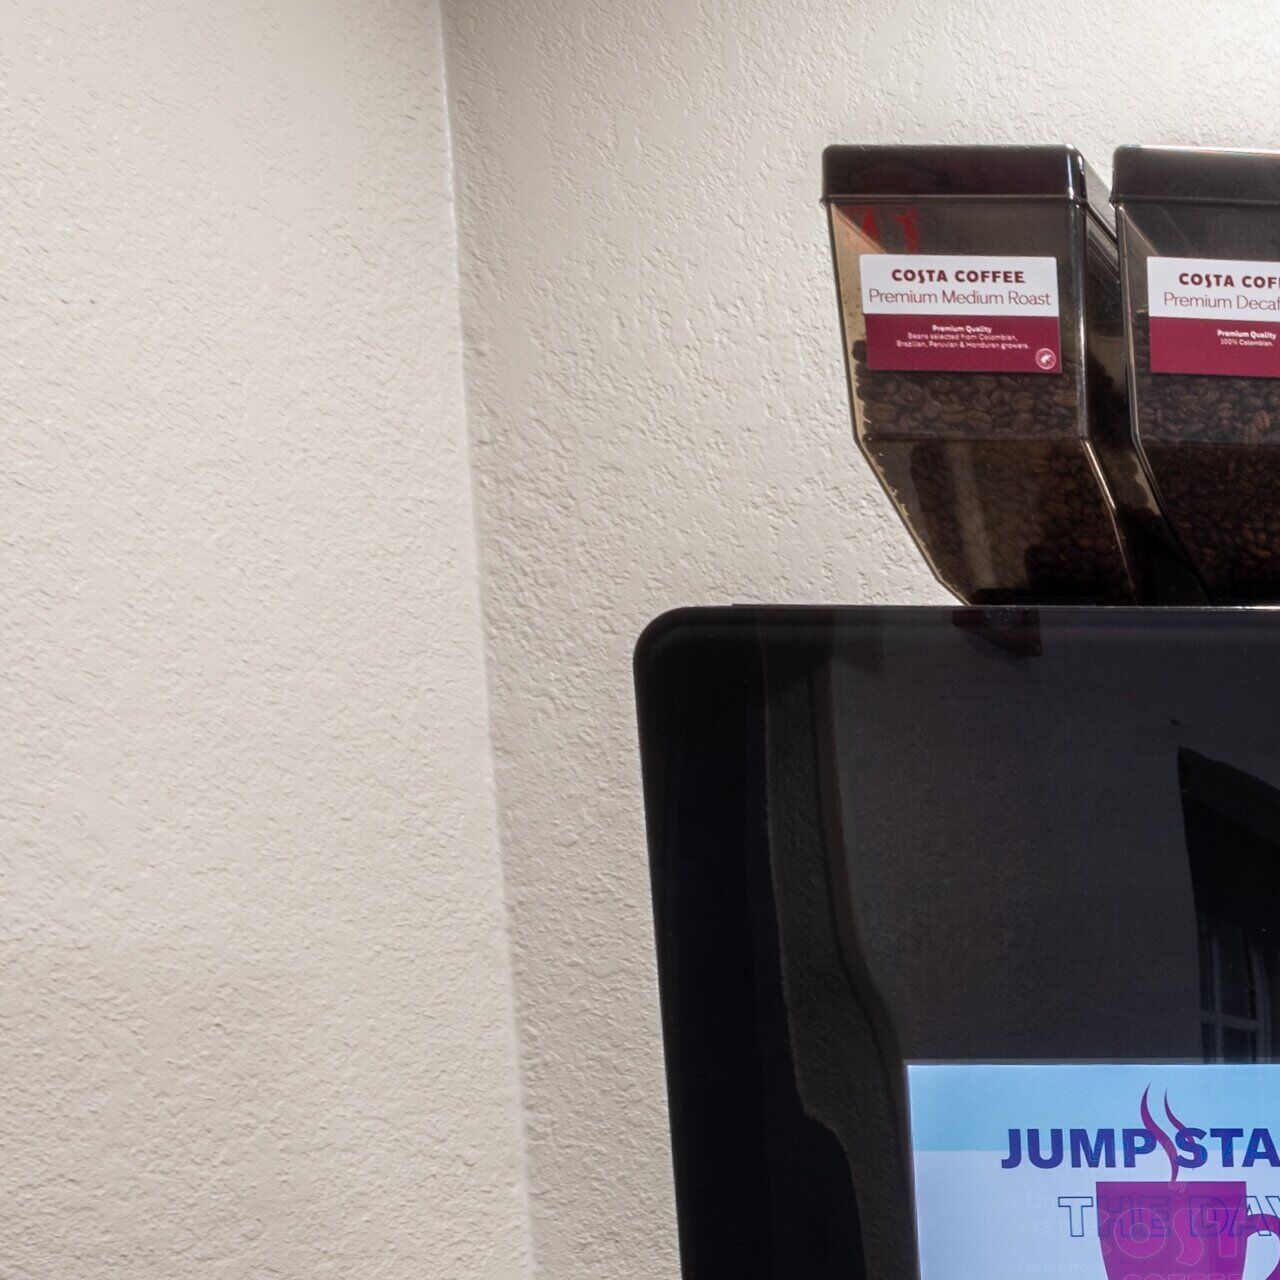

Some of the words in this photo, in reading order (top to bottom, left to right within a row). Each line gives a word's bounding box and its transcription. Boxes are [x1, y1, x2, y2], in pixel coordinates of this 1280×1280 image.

[891, 269, 948, 283] COSTA
[955, 270, 1025, 283] COFFEE
[1179, 273, 1235, 288] COSTA
[869, 288, 937, 304] Premium
[942, 290, 1004, 305] Medium
[1008, 291, 1052, 306] Roast
[1164, 292, 1232, 309] Premium
[1237, 295, 1280, 310] Decaf
[932, 324, 964, 332] Premium
[965, 325, 992, 334] Quality
[1217, 329, 1249, 338] Premium
[1250, 331, 1277, 340] Quality
[1220, 338, 1238, 346] 100%
[1001, 1128, 1157, 1169] JUMP
[1058, 1195, 1172, 1237] THE
